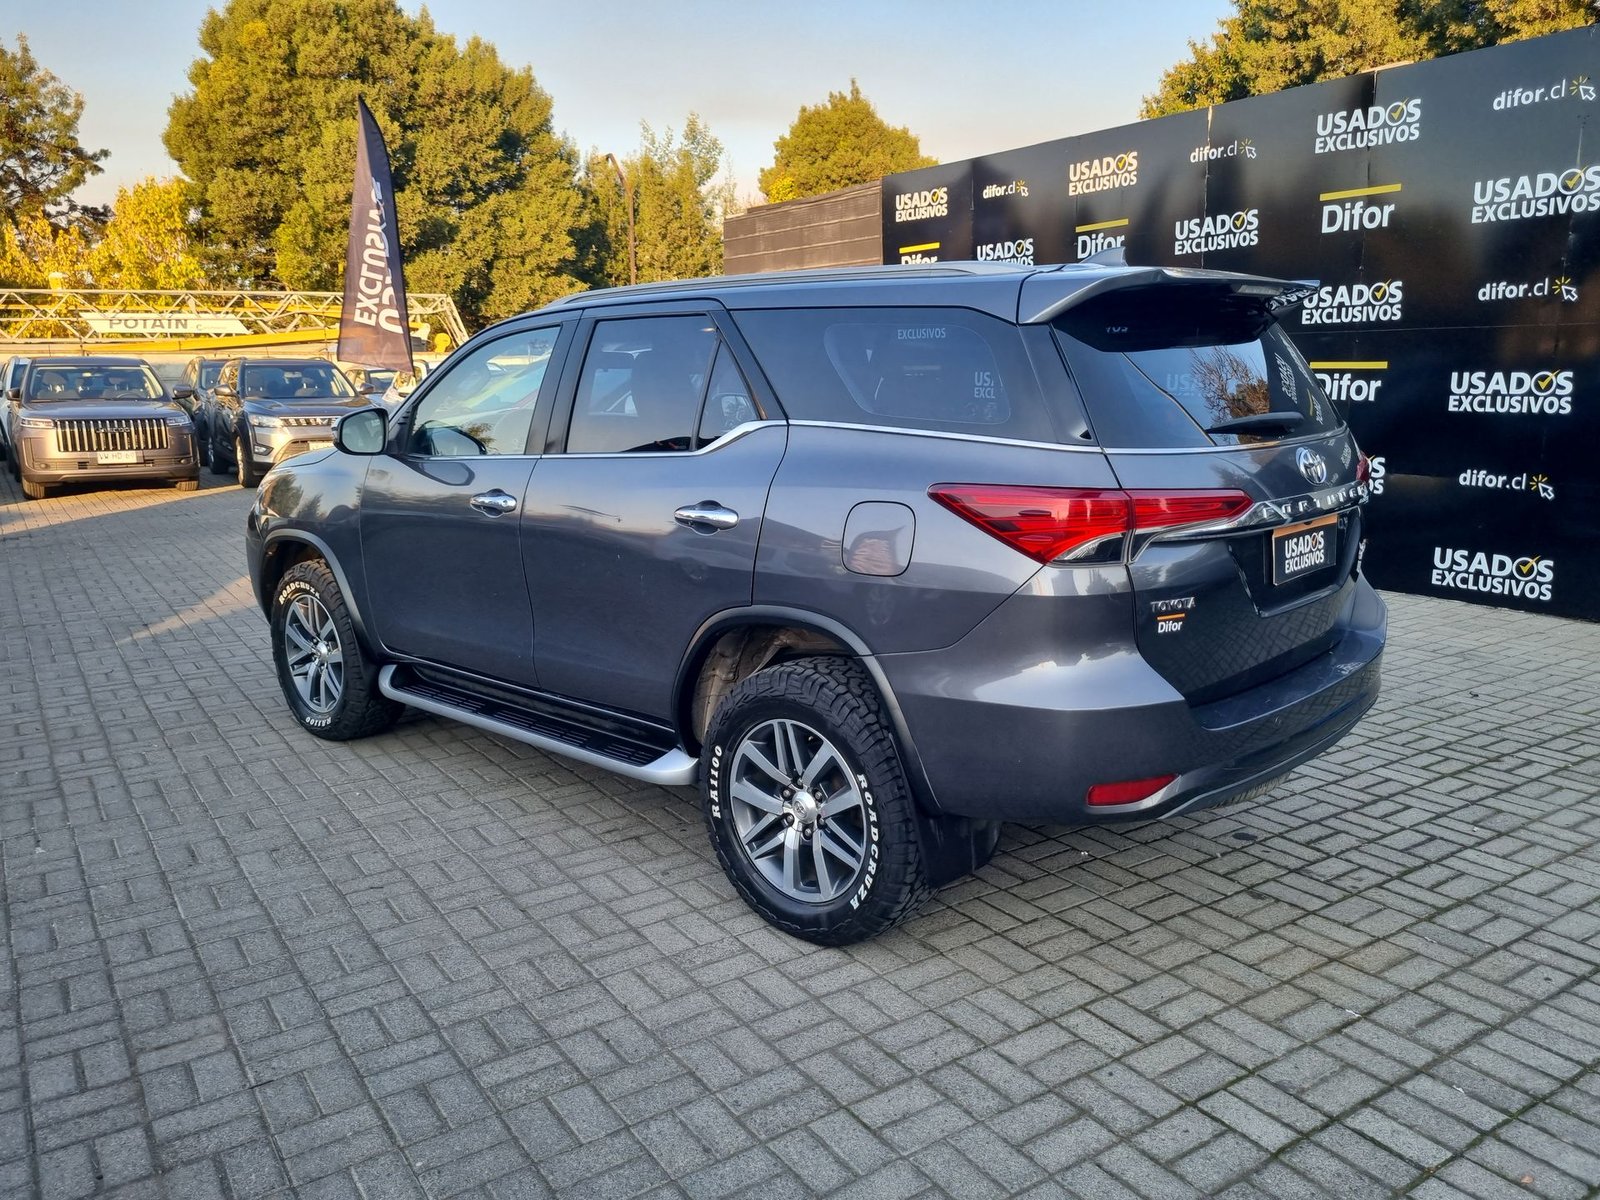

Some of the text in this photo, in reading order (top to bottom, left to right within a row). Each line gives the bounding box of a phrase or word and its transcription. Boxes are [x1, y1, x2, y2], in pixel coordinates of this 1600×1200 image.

[1493, 79, 1566, 111] difor.cl
[1316, 99, 1421, 136] USADOS
[1315, 123, 1420, 154] EXCLUSIVOS
[1190, 140, 1238, 162] difor.cl
[1070, 152, 1138, 182] USADOS
[983, 183, 1016, 199] difor.cl
[1069, 172, 1137, 196] EXCLUSIVOS
[1473, 166, 1600, 204] USADOS
[896, 188, 948, 210] USADOS
[1471, 192, 1600, 223] EXCLUSIVOS
[896, 203, 948, 222] EXCLUSIVOS
[1175, 209, 1258, 240] USADOS
[1321, 201, 1395, 233] Difor
[977, 238, 1034, 261] USADOS
[1174, 231, 1258, 255] EXCLUSIVOS
[1303, 281, 1403, 308] USADOS
[1478, 278, 1548, 301] difor.cl
[109, 319, 188, 330] POTAIN
[1302, 304, 1402, 324] EXCLUSIVOS
[898, 328, 946, 339] EXCLUSIVOS
[1450, 371, 1573, 396] USADOS
[1448, 395, 1572, 414] EXCLUSIVOS
[1459, 470, 1526, 490] difor.cl
[1285, 531, 1324, 558] USADOS
[1285, 550, 1324, 574] EXCLUSIVOS
[1433, 547, 1554, 583] USADOS
[1431, 569, 1552, 600] EXCLUSIVOS
[1150, 597, 1196, 612] TOYOTA
[1158, 621, 1182, 633] Difor
[850, 774, 878, 910] ROADCRUZA
